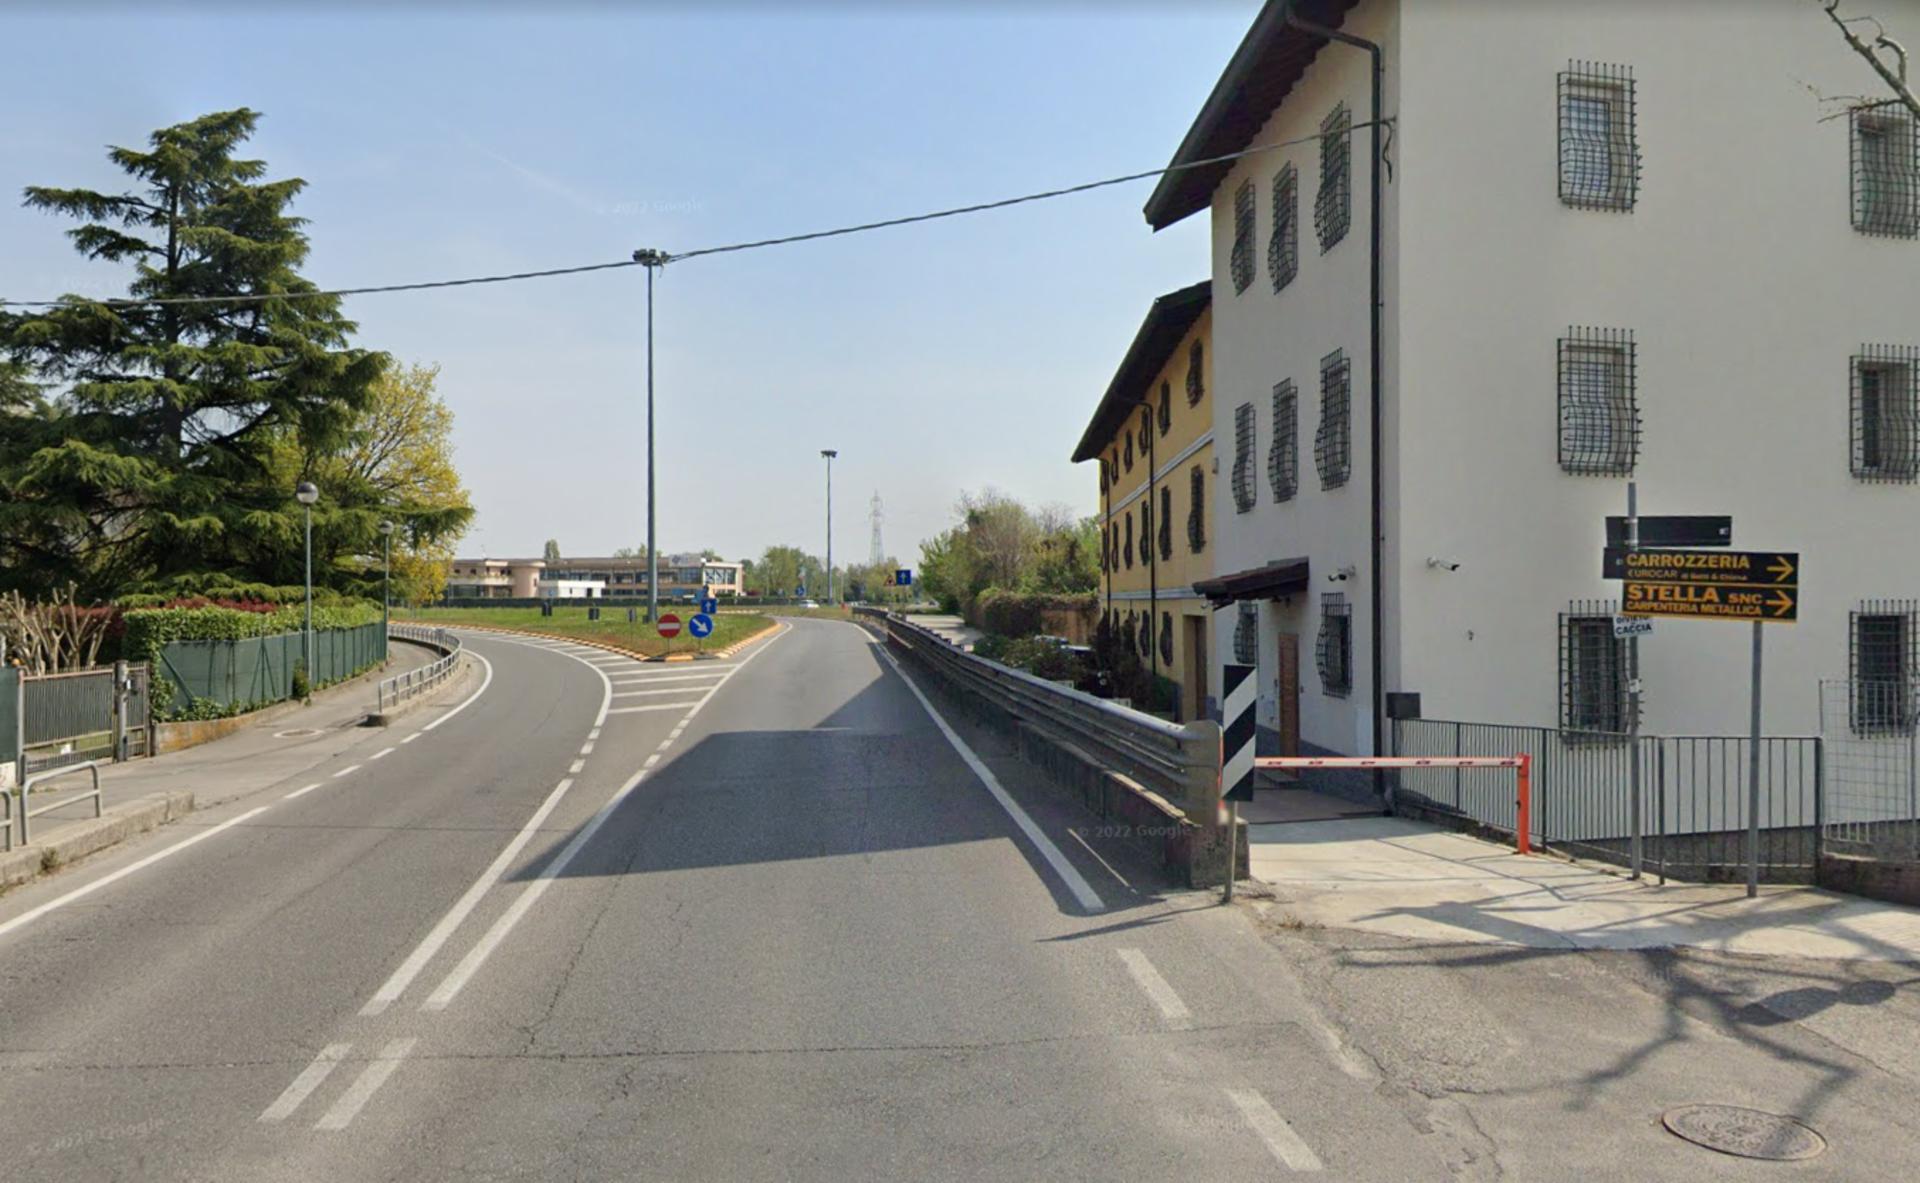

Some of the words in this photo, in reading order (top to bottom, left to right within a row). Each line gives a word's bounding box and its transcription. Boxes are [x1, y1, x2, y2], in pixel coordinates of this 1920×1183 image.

[1626, 553, 1750, 568] CARROZZERIA
[1627, 584, 1720, 602] STELLA
[1728, 593, 1763, 605] SNC
[1626, 601, 1699, 613] CARPENTERIA
[1700, 604, 1763, 616] METALLICA
[1616, 623, 1652, 635] CACCIA
